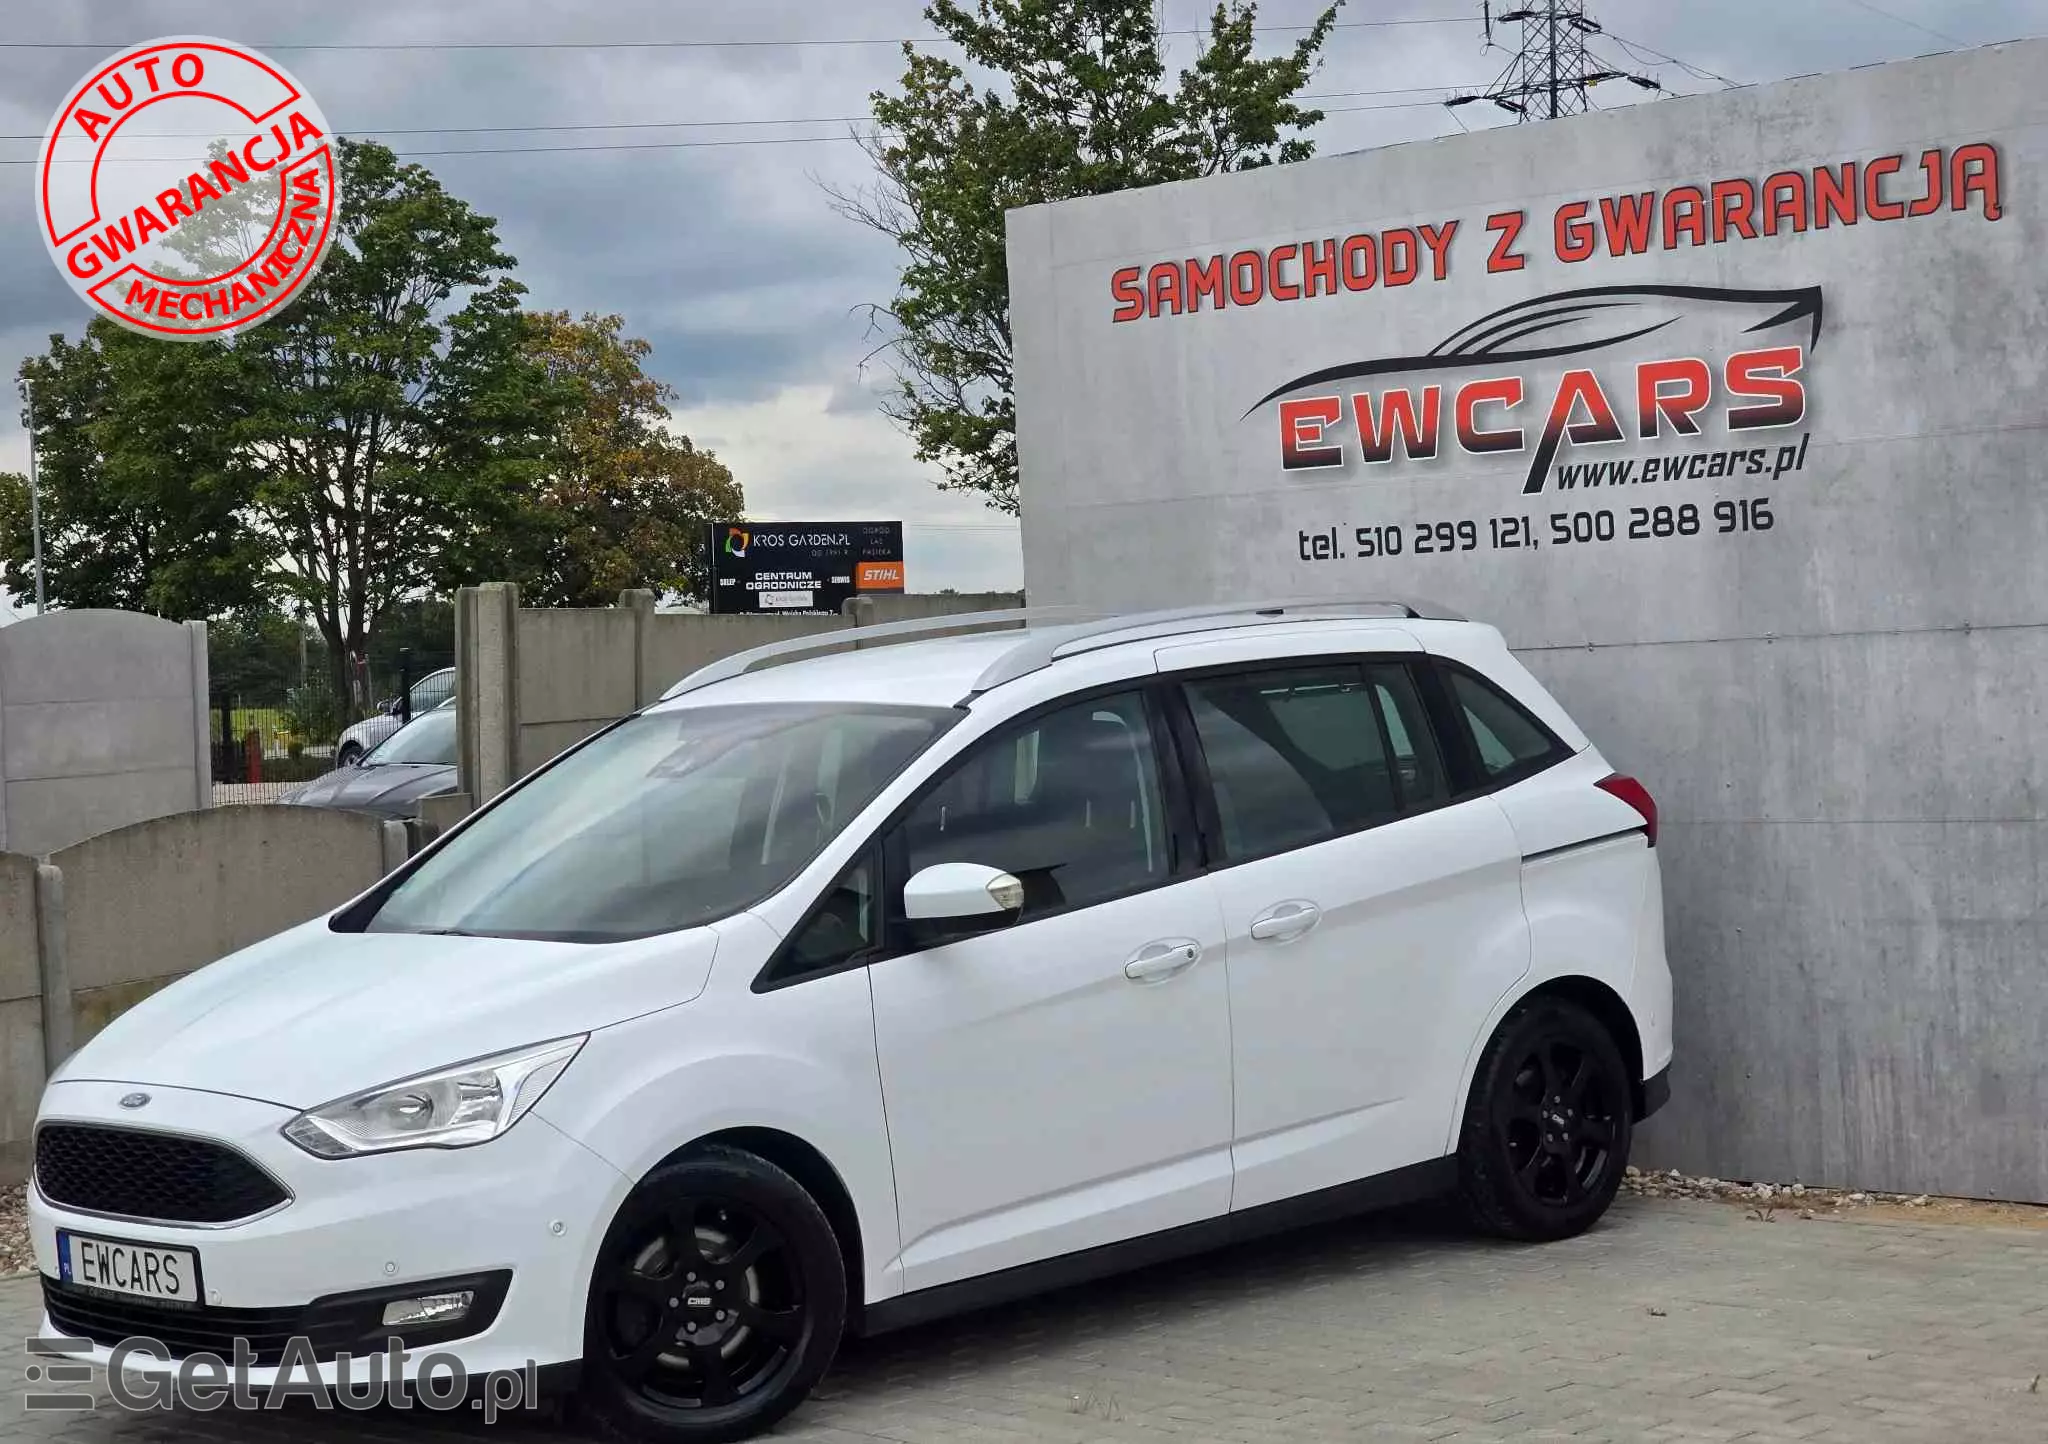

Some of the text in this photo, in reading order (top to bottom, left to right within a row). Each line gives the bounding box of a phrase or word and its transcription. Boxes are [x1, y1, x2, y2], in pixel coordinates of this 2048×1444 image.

[1111, 142, 2003, 323] SAMOCHODY Z GWARANCJĄ
[1277, 346, 1806, 496] EWCARS
[1555, 432, 1811, 491] www.ewcars.pl
[753, 533, 851, 547] KROS GARDEN.PL
[1298, 498, 1775, 563] tel. 510 299 121, 500 288 916
[745, 580, 822, 590] OGRODNICZE
[755, 572, 812, 581] CENTRUM
[863, 569, 901, 581] STIHL
[80, 1240, 181, 1294] EWCARS
